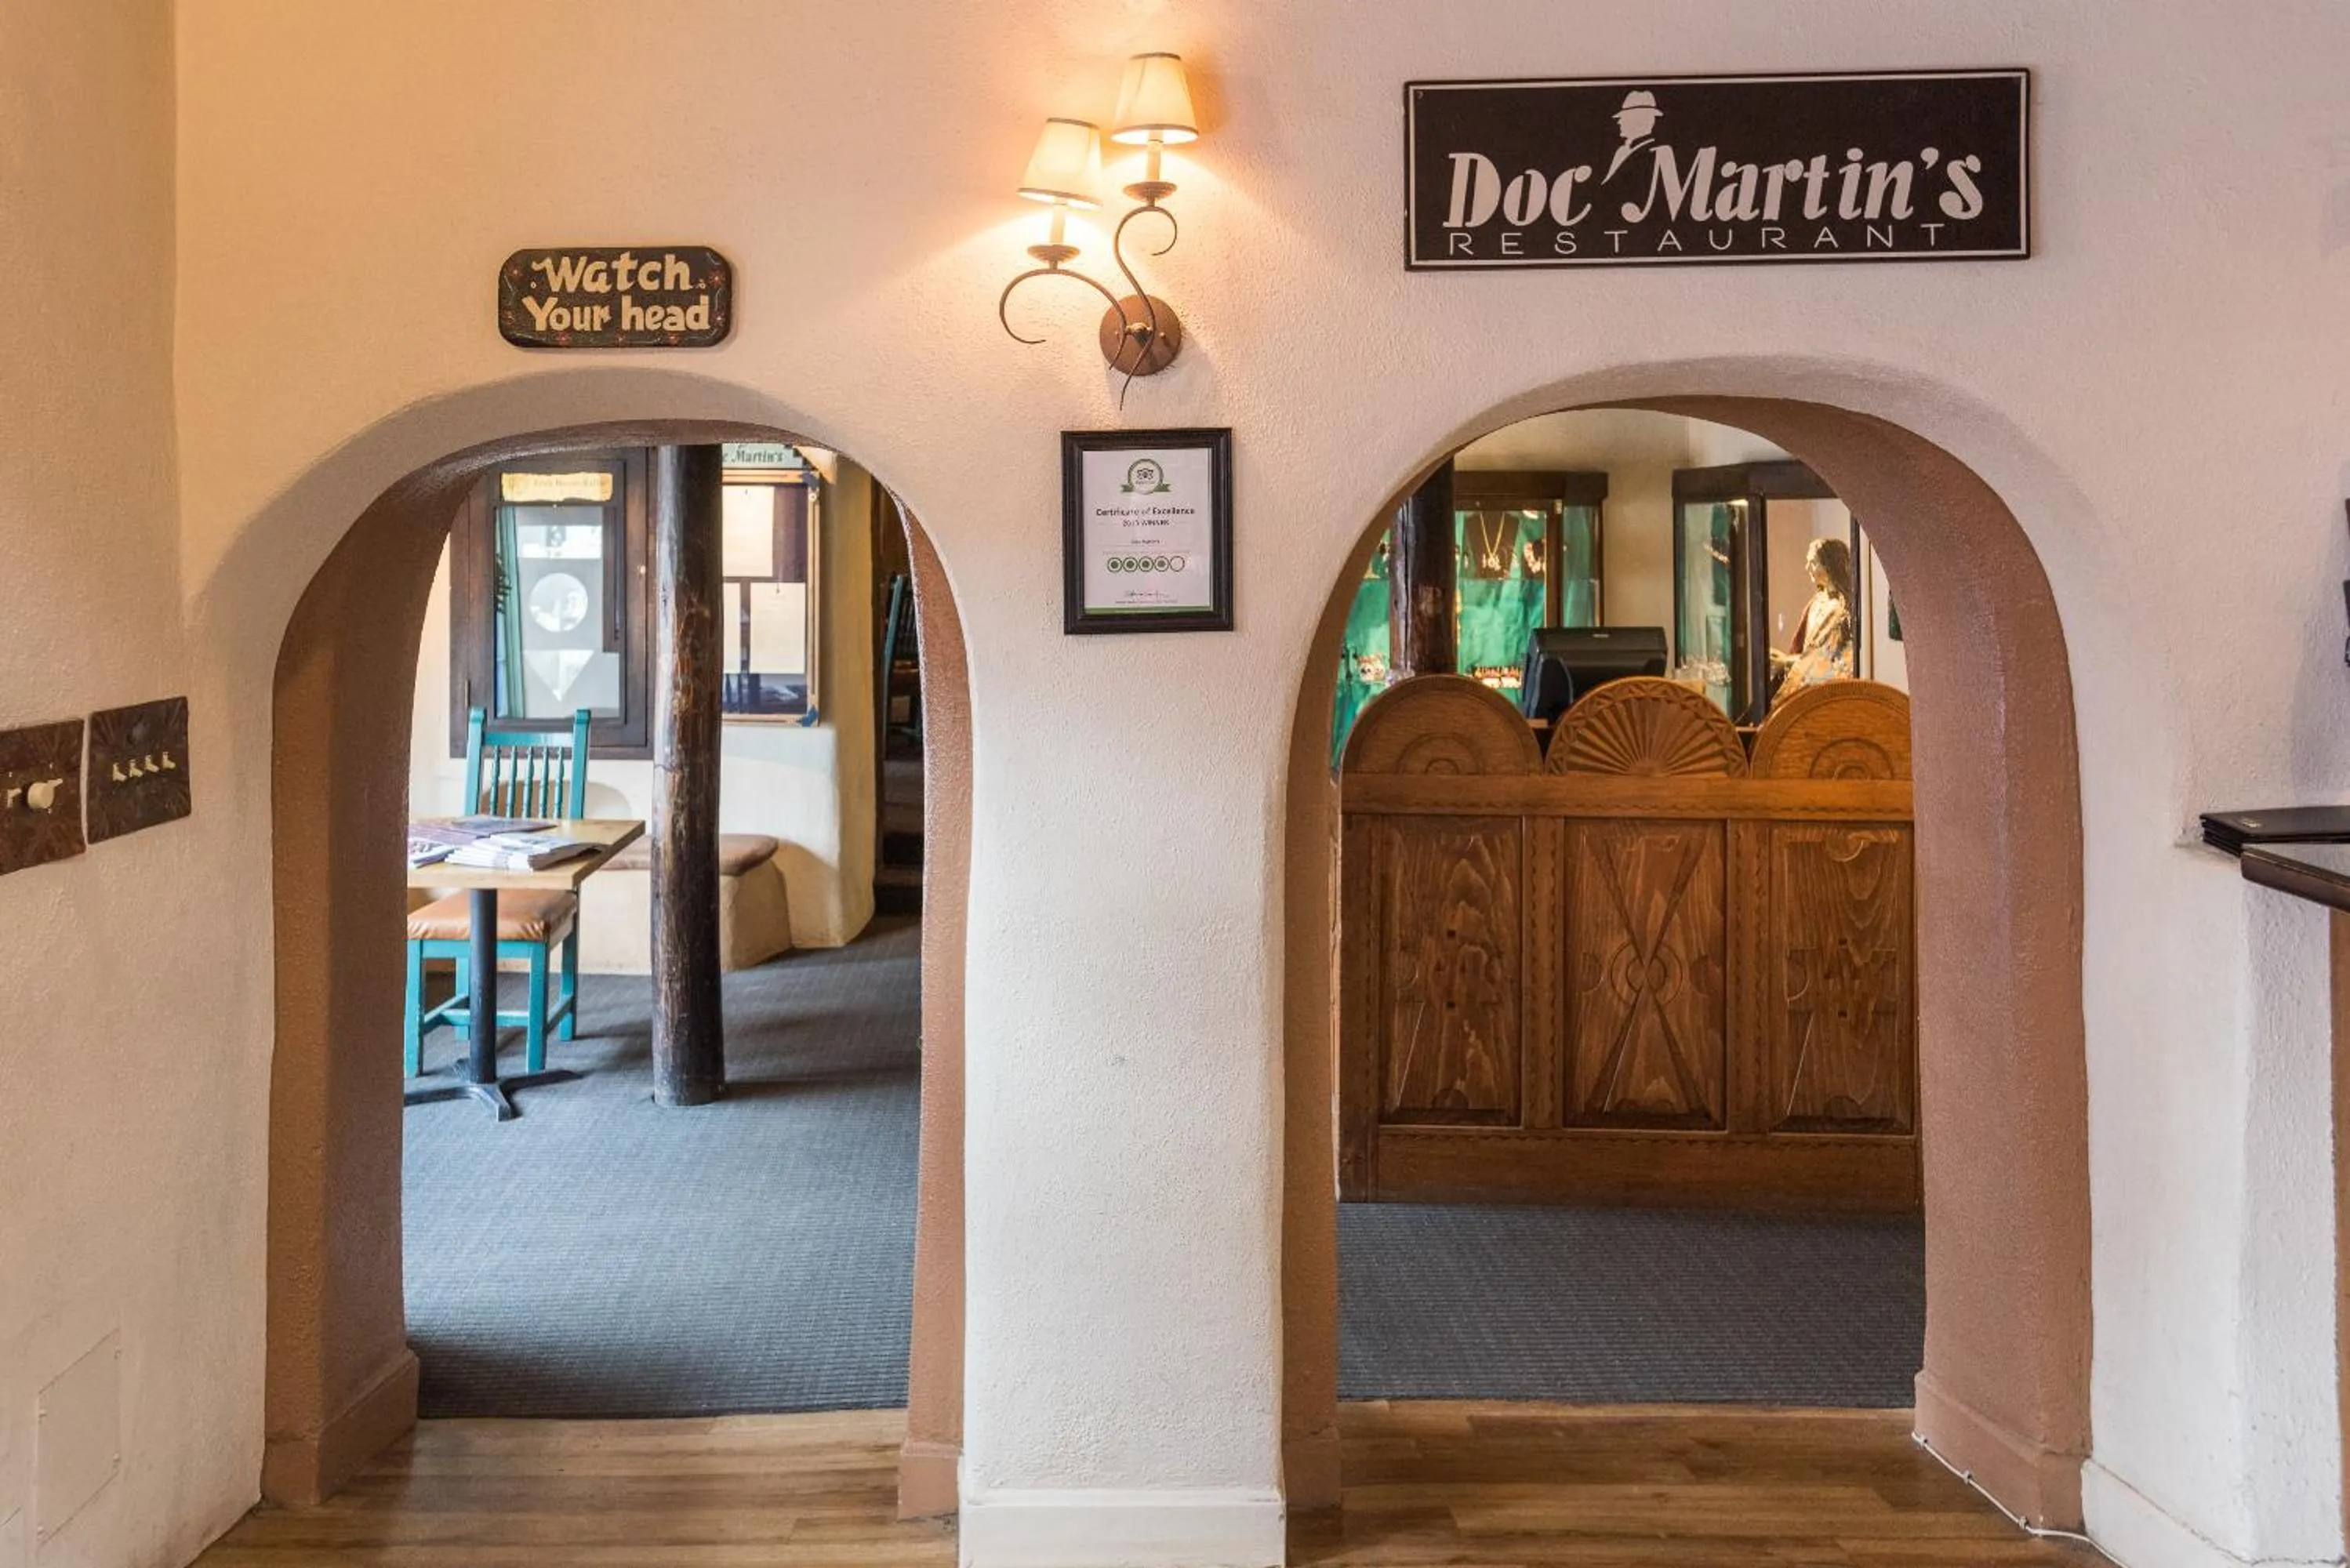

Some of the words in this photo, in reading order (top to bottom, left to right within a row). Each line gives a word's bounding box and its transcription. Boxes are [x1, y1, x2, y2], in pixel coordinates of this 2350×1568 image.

[1442, 152, 1592, 228] Doc
[1621, 144, 1984, 223] Martin's
[1449, 223, 1945, 256] RESTAURANT
[532, 251, 693, 294] Watch
[521, 296, 612, 332] Your
[620, 294, 711, 332] head
